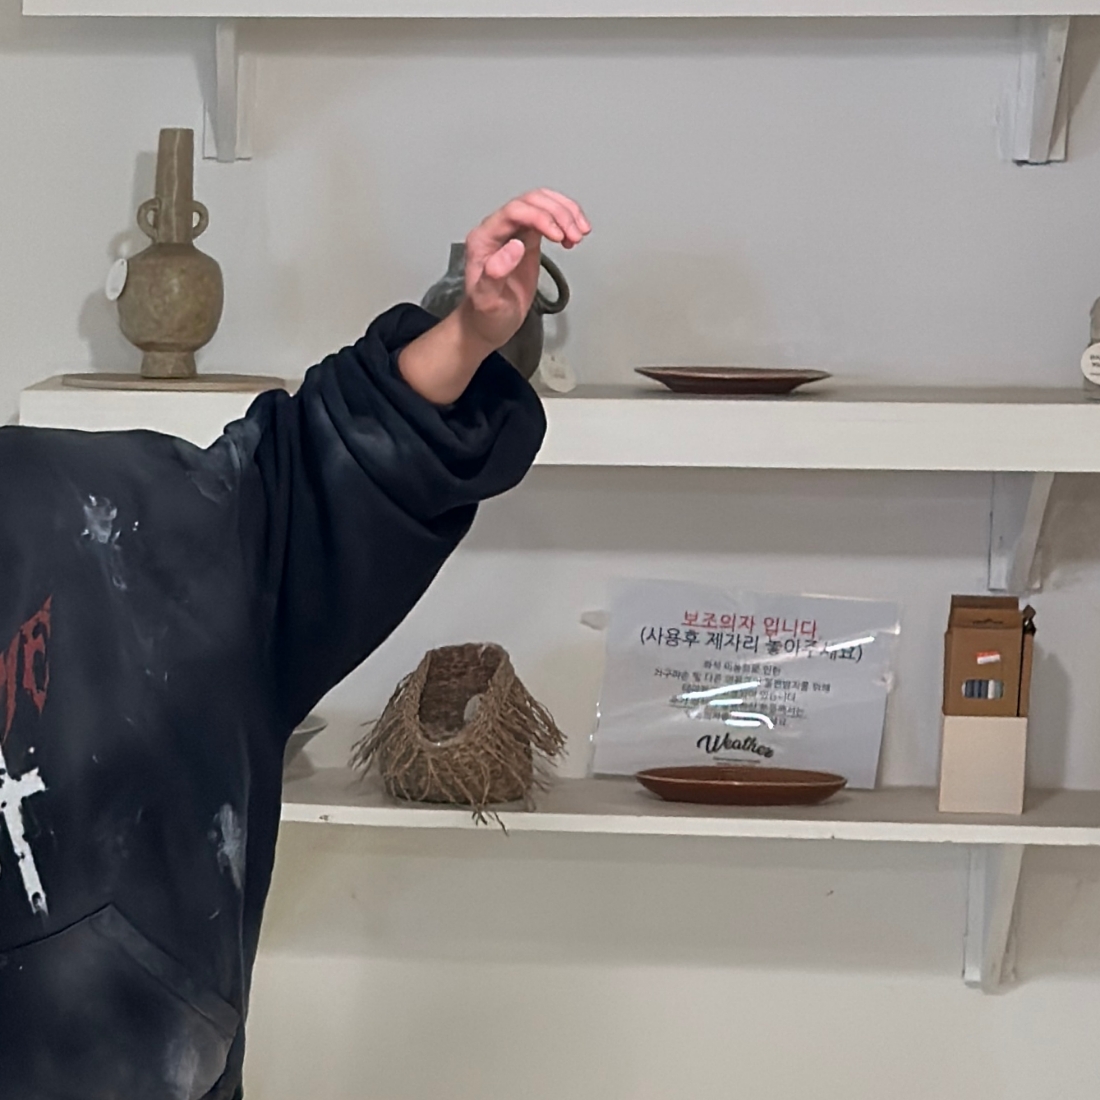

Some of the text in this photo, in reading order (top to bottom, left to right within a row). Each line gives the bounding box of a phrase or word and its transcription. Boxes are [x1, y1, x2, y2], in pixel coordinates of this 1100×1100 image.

[681, 611, 818, 640] 보조의자 입니다
[640, 627, 700, 648] (사용후
[705, 631, 759, 653] 제자리
